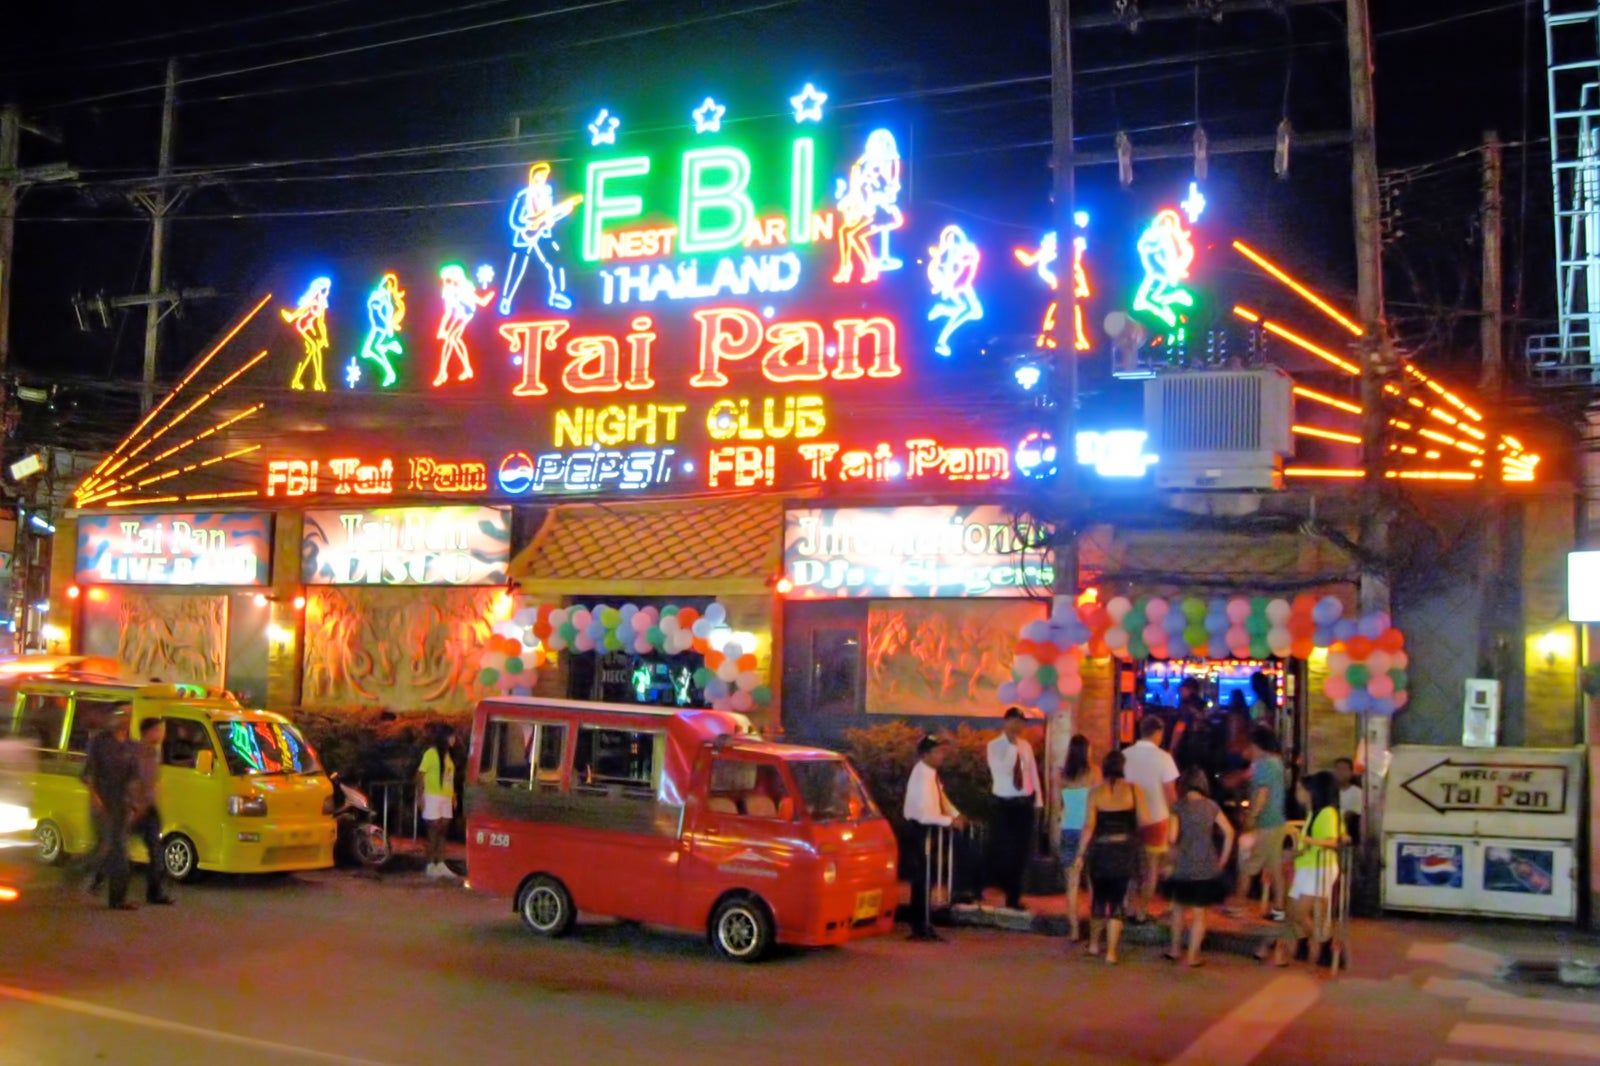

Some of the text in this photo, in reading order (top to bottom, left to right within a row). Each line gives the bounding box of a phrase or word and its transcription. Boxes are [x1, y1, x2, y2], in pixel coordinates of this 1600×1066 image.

[599, 251, 801, 304] THAILAND
[499, 306, 901, 396] Tai Pan
[553, 396, 827, 447] NIGHT CLUB
[266, 439, 1011, 497] FBI Tai Pan PEPSI FBI Tai Pan
[120, 520, 227, 555] Tai Pan
[100, 551, 168, 581] LIVE
[1495, 783, 1549, 807] Pan
